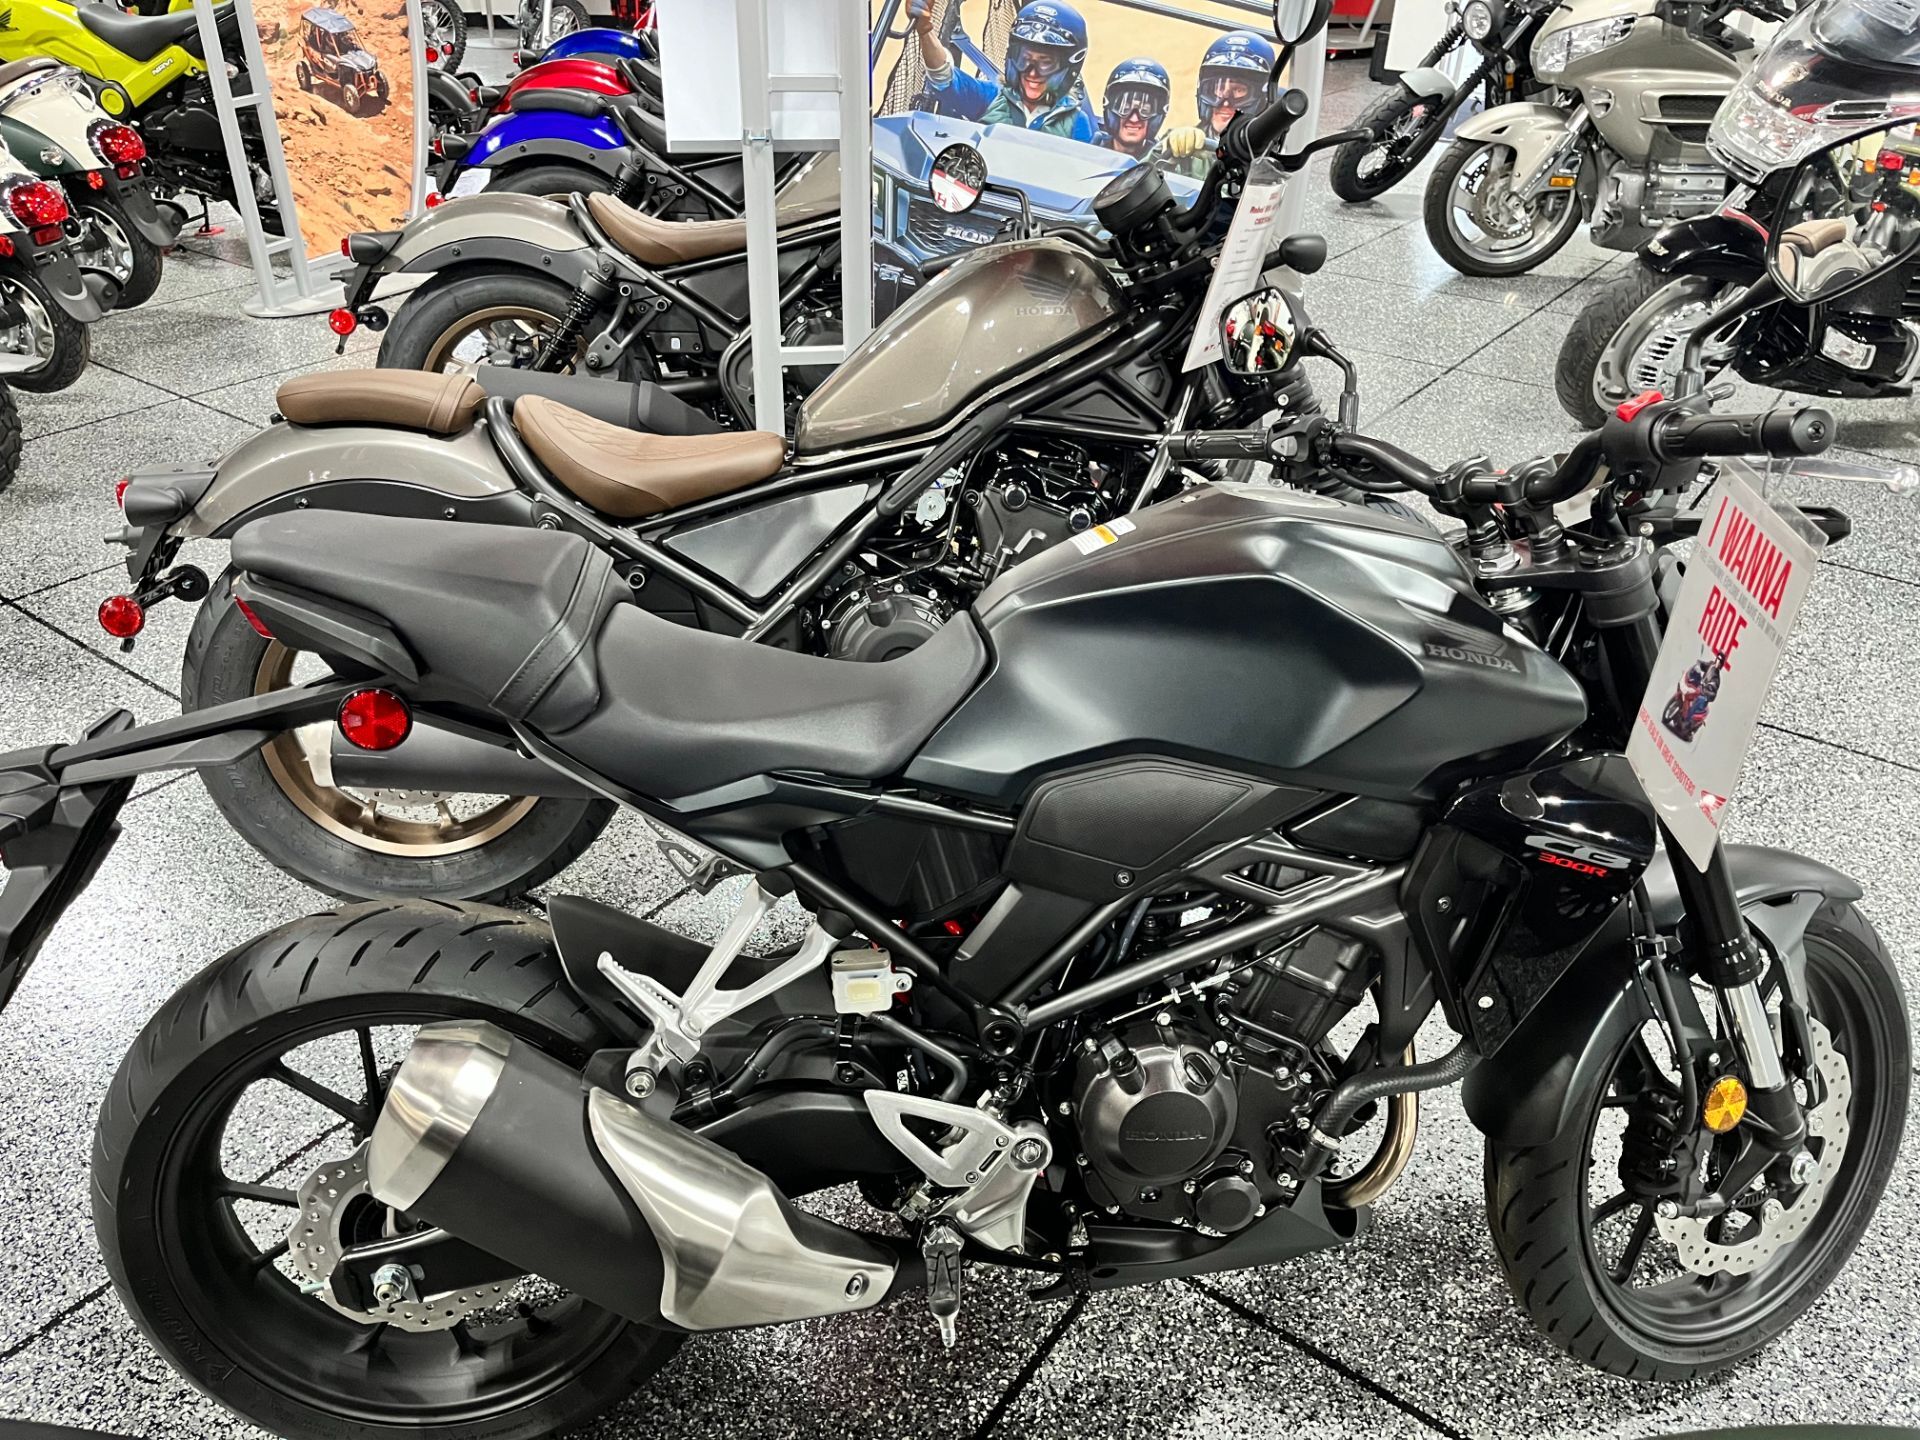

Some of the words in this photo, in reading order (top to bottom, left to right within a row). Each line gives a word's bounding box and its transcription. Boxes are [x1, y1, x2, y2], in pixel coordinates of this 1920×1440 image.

[152, 58, 174, 75] NAVI
[943, 223, 996, 245] HON
[1015, 306, 1074, 317] HONDA
[1707, 495, 1729, 547] I
[1718, 505, 1793, 621] WANNA
[1698, 584, 1748, 672] RIDE
[1424, 642, 1521, 674] HONDA
[1661, 744, 1675, 767] GREAT
[1671, 760, 1696, 797] SCOOTERS
[1525, 835, 1631, 869] CB
[1538, 851, 1608, 877] 300R
[1125, 1128, 1208, 1142] HONDA
